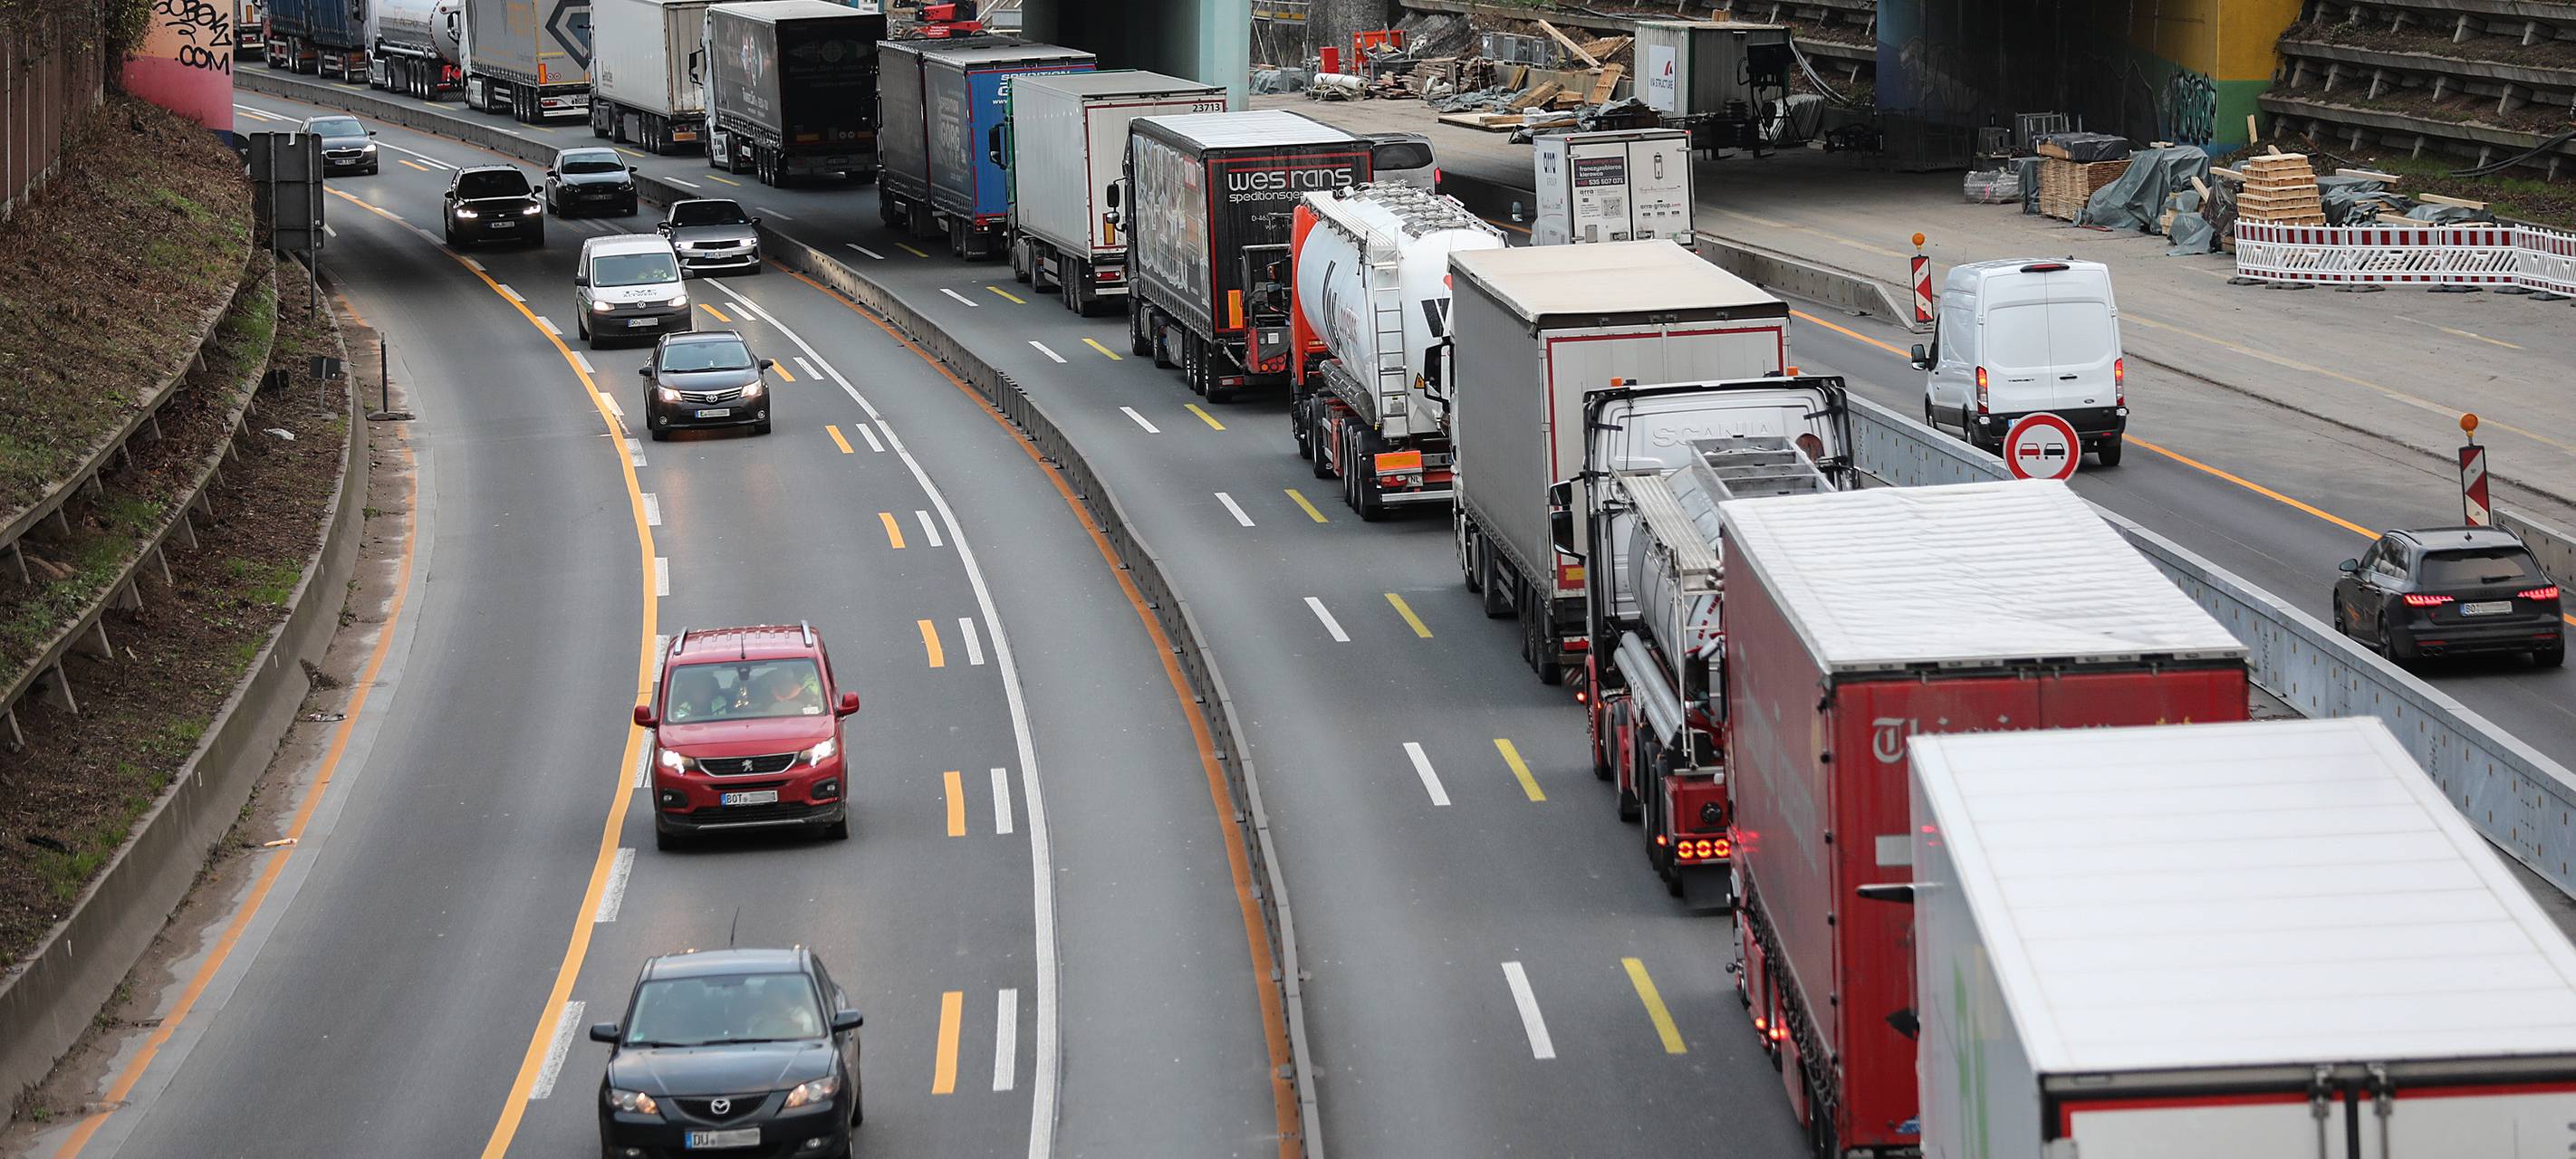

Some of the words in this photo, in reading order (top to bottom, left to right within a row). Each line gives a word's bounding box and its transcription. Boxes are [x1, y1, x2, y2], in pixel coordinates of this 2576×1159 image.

[1192, 102, 1220, 113] 23713
[1409, 474, 1420, 484] NL
[726, 793, 743, 804] BOT
[693, 1133, 709, 1145] DU
